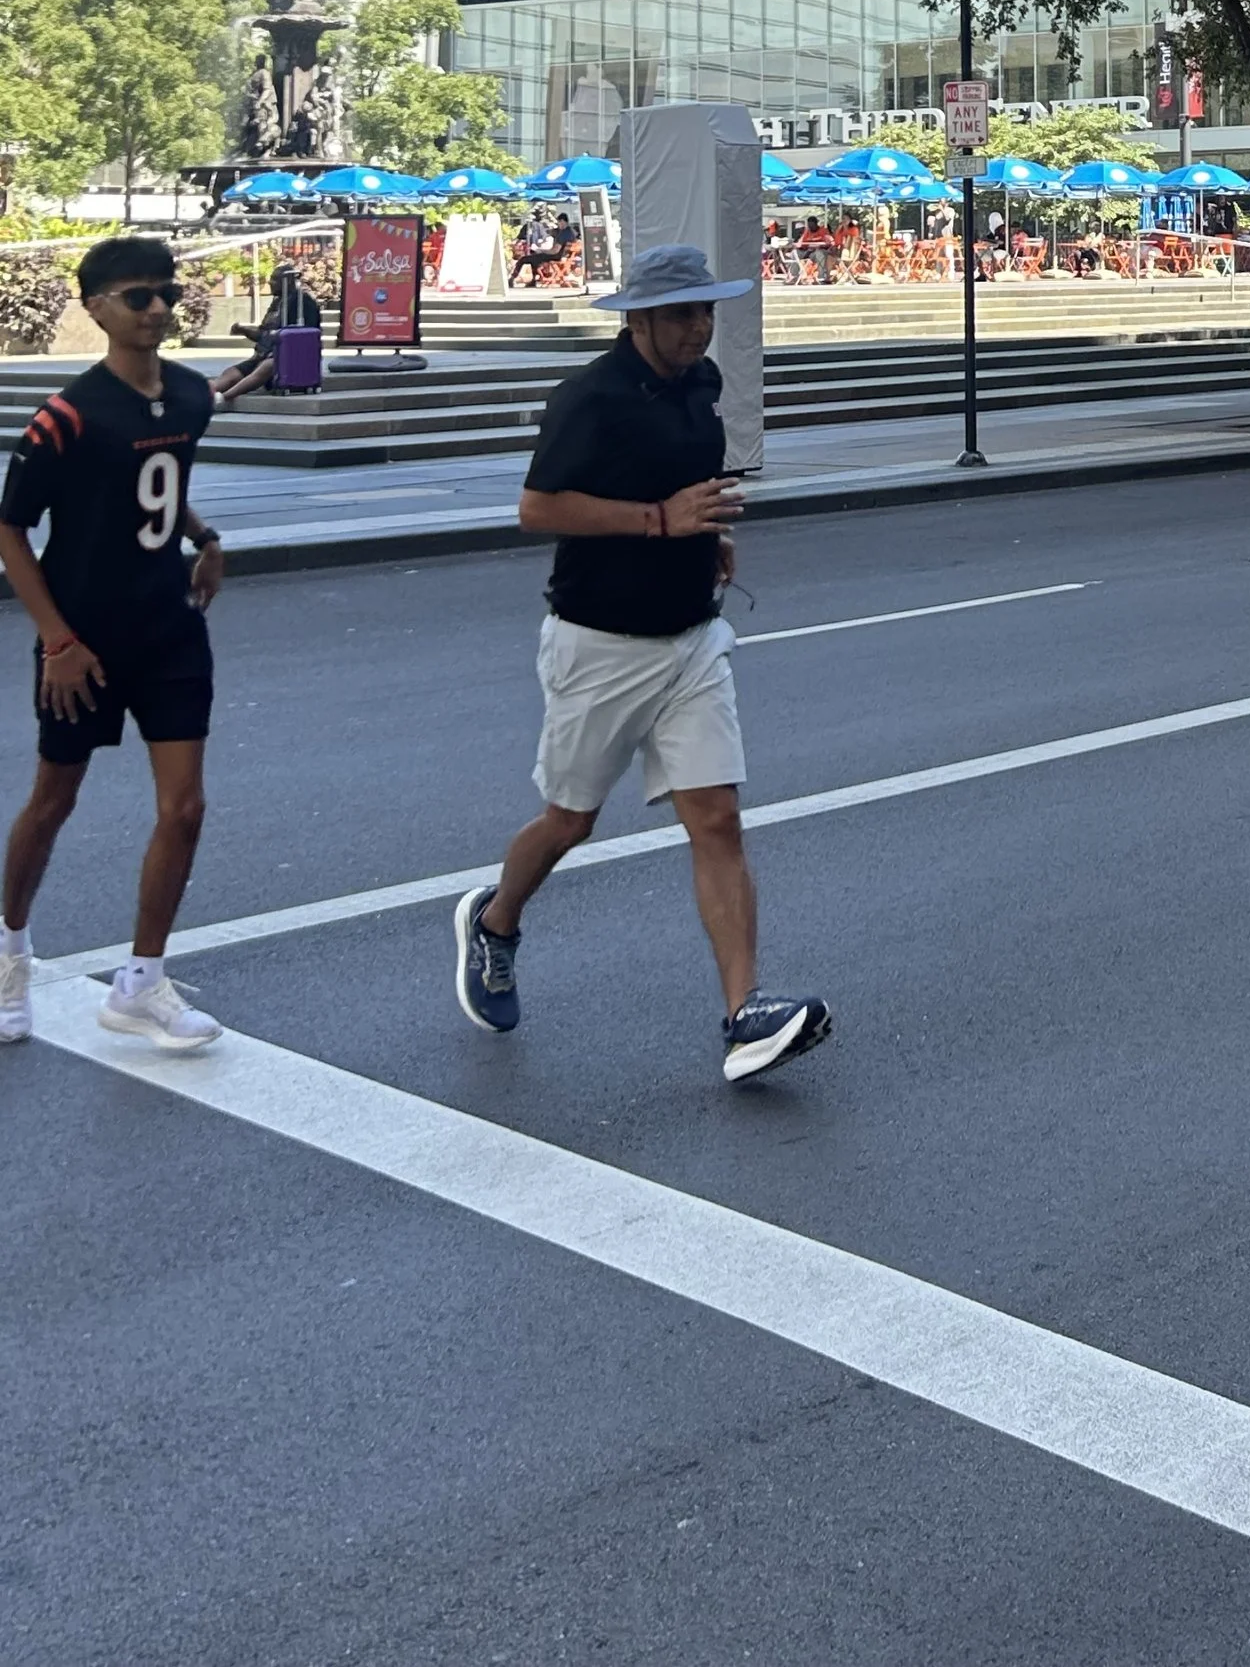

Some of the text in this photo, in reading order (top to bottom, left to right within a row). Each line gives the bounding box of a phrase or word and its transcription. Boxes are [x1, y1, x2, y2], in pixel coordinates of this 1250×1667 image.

[946, 86, 958, 101] NO
[954, 106, 979, 119] ANY
[952, 120, 982, 133] TIME
[365, 248, 412, 276] Salsa
[137, 452, 179, 550] 9
